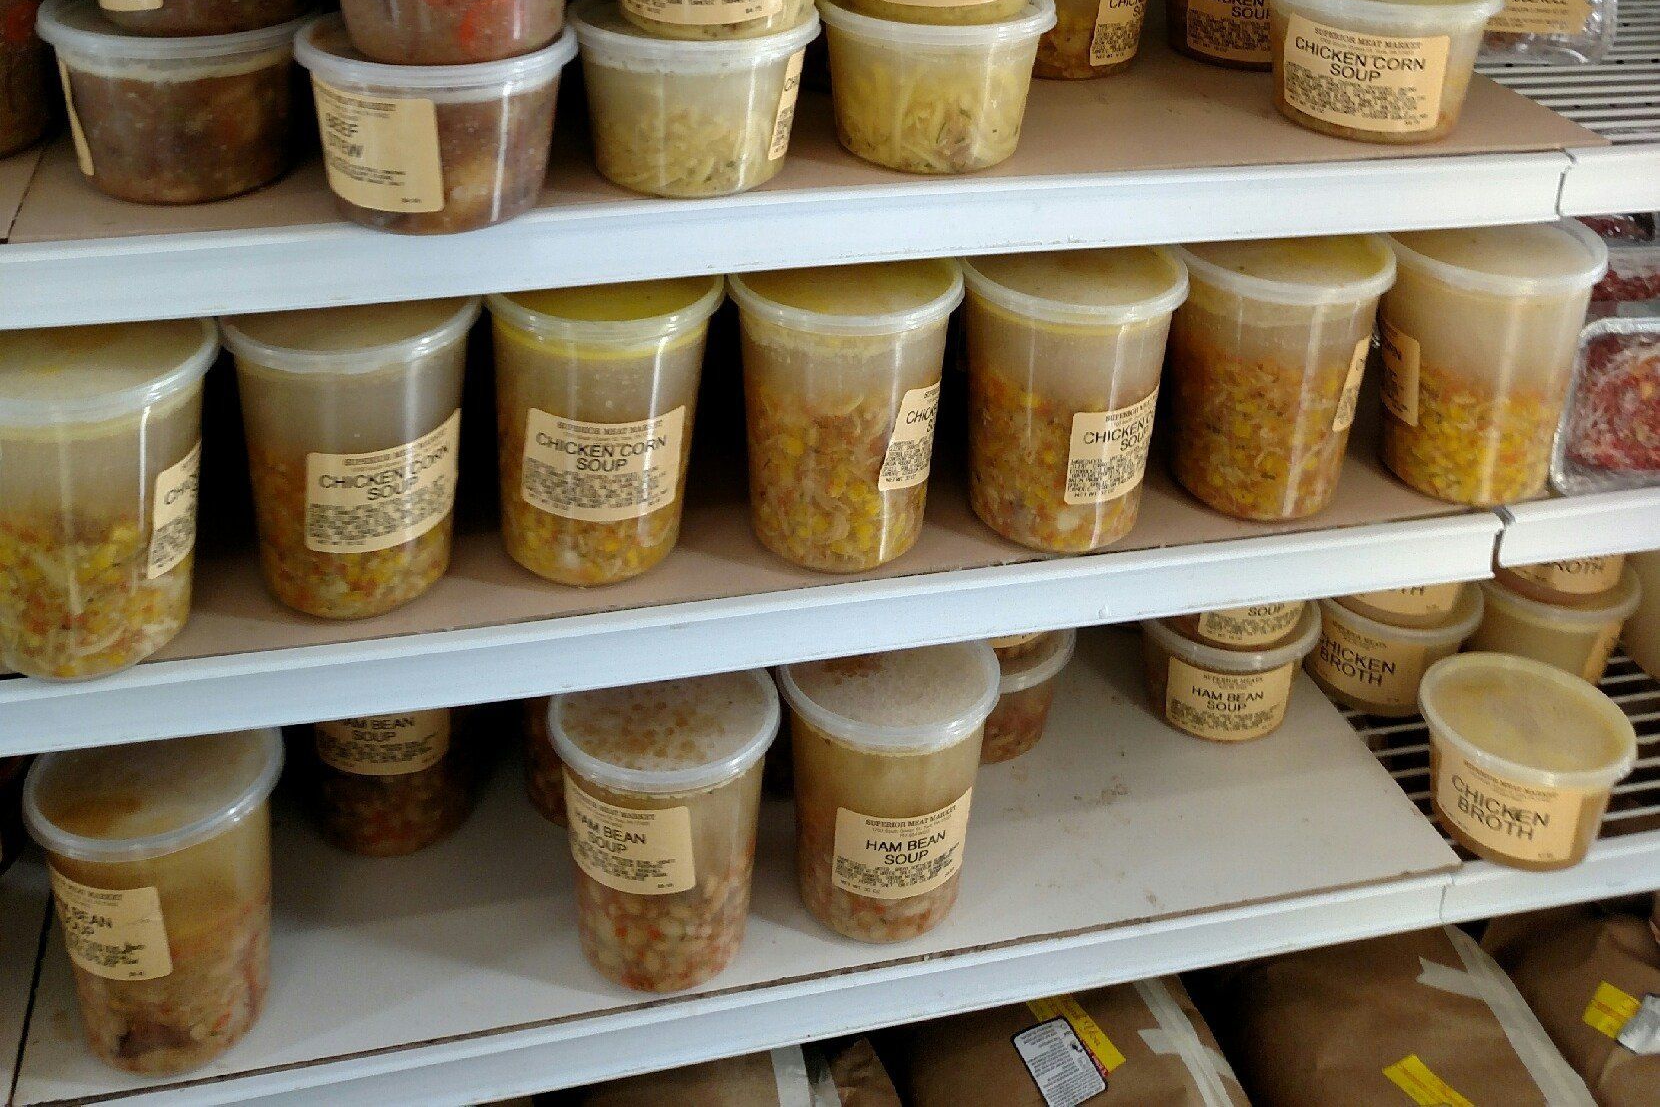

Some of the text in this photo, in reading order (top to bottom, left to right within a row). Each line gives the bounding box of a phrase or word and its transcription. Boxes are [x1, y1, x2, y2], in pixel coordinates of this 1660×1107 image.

[1314, 27, 1356, 44] SUPERIOR
[1356, 37, 1383, 48] MEAT
[1295, 36, 1367, 67] CHICKEN
[1373, 56, 1426, 71] CORN
[1329, 63, 1381, 82] SOUP
[1083, 420, 1145, 445] CHICKEN
[535, 432, 667, 457] CHICKEN CORN
[576, 457, 628, 472] SOUP
[1320, 645, 1383, 688] BROTH
[1191, 685, 1265, 702] HAM BEAN
[1206, 701, 1248, 712] SOUP
[352, 730, 397, 742] SOUP
[1451, 774, 1551, 829] CHICKEN
[865, 804, 957, 828] SUPERIOR MEAT MARKET
[1457, 797, 1535, 842] BROTH
[587, 831, 628, 854] SOUP
[603, 825, 648, 844] BEAN
[865, 829, 947, 853] HAM BEAN
[884, 849, 930, 865] SOUP
